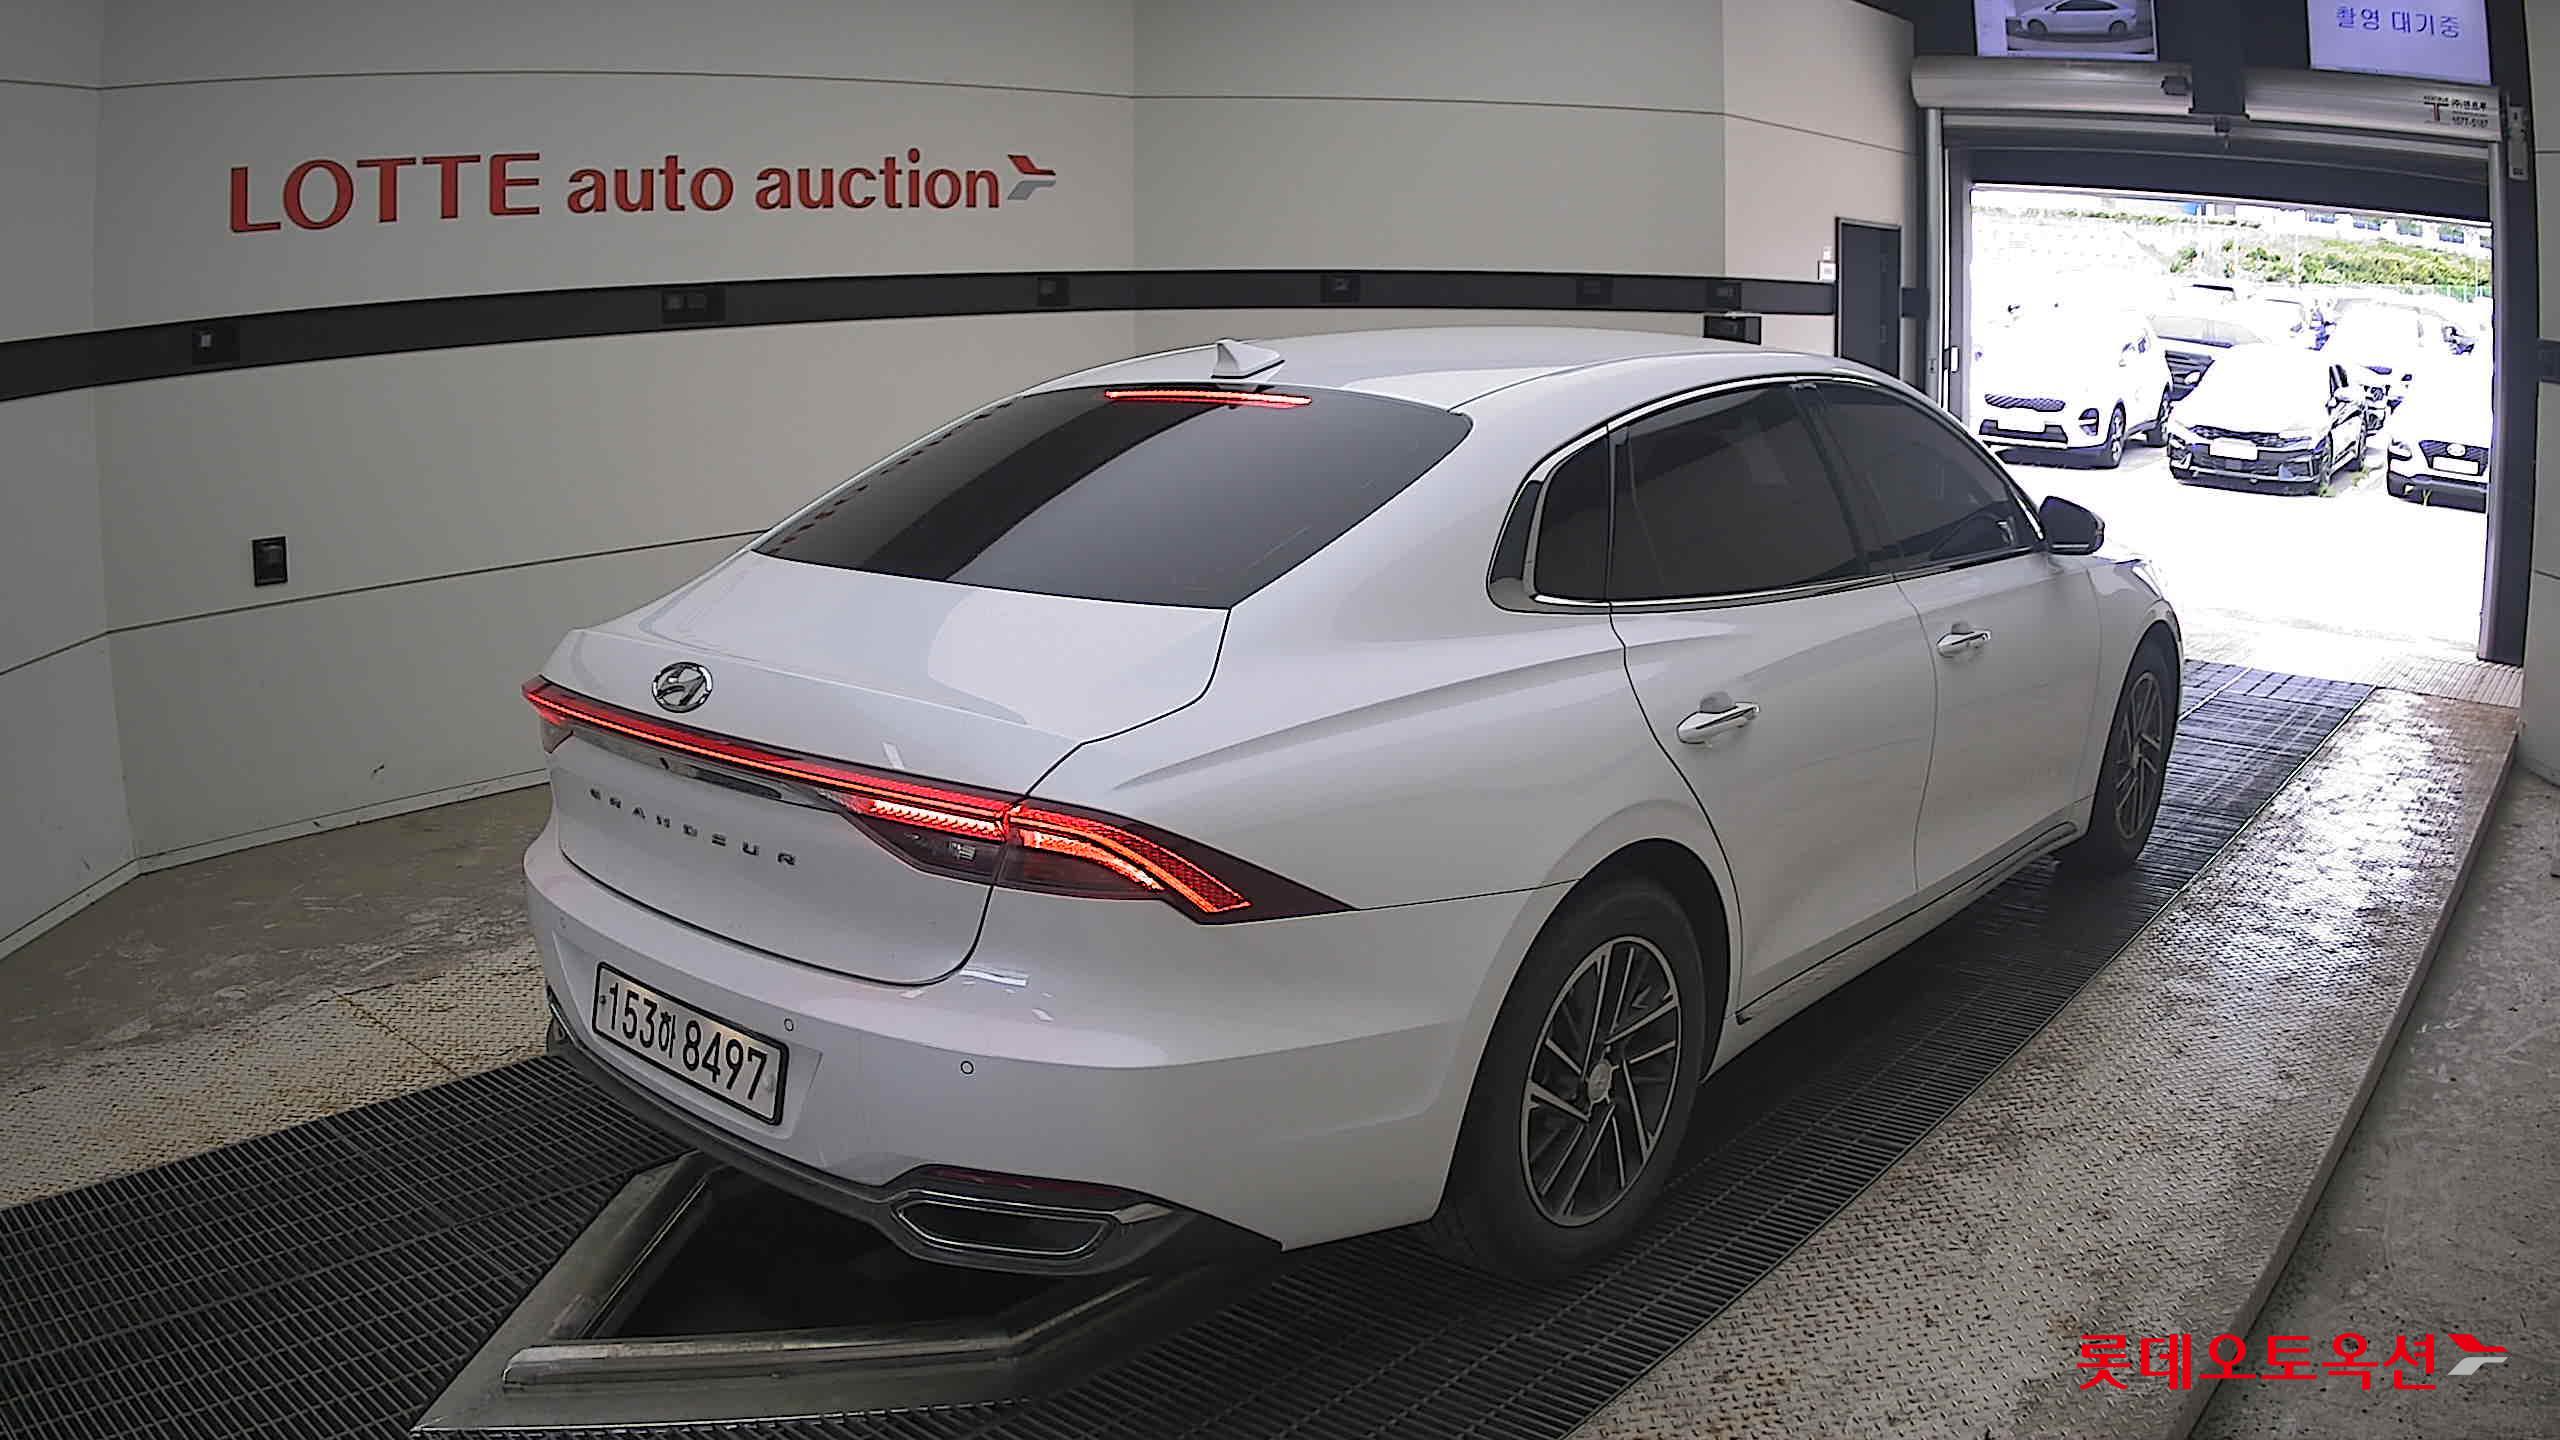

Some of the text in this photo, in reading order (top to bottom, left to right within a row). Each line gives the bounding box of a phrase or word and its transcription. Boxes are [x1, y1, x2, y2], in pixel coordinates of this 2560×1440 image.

[2336, 6, 2460, 39] 촬영 대기중
[230, 147, 1001, 233] LOTTE auto auction
[609, 982, 768, 1101] 153하 8497
